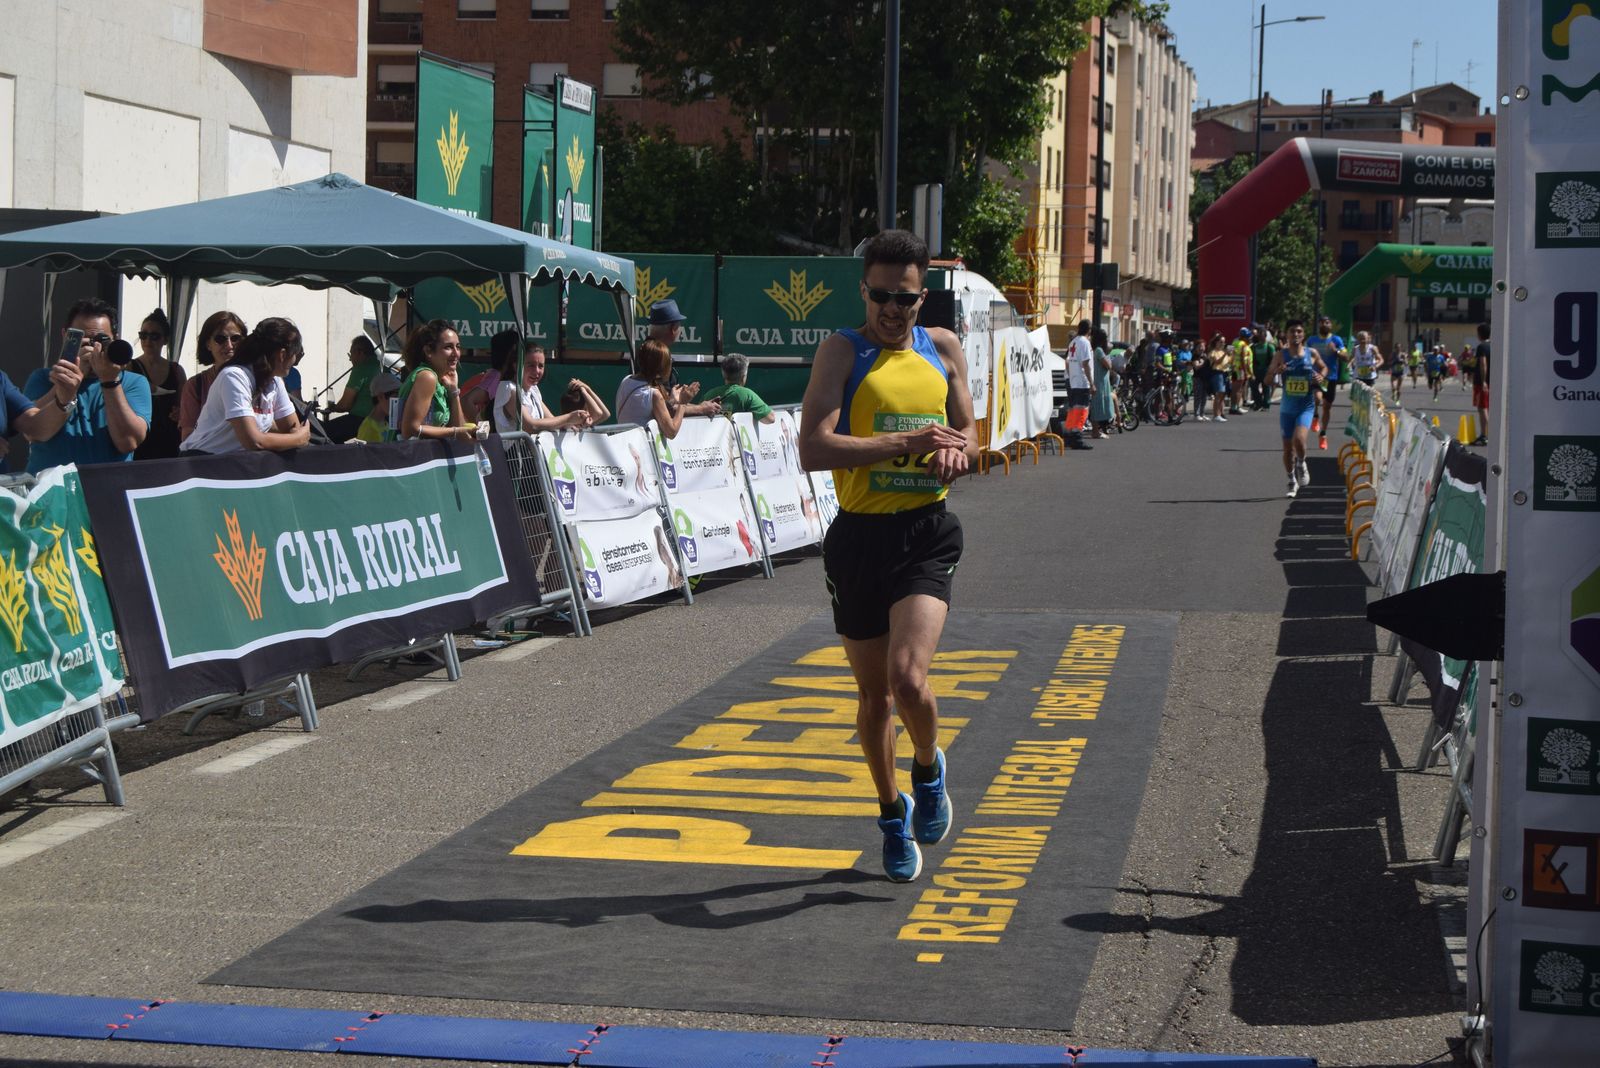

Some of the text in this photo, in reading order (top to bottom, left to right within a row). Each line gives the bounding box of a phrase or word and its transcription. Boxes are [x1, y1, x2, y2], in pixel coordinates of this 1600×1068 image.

[1415, 155, 1447, 168] CON
[1451, 157, 1469, 169] EL
[1352, 167, 1397, 179] ZAMORA
[1414, 172, 1487, 188] GANAMOS
[1435, 255, 1474, 270] CAJA
[579, 323, 628, 341] CAJA
[735, 327, 785, 346] CAJA
[1289, 382, 1305, 391] 173
[276, 512, 462, 605] CAJA RURAL
[1031, 624, 1126, 720] DISEÑO INTERIORES
[896, 737, 1088, 943] REFORMA INTEGRAL
